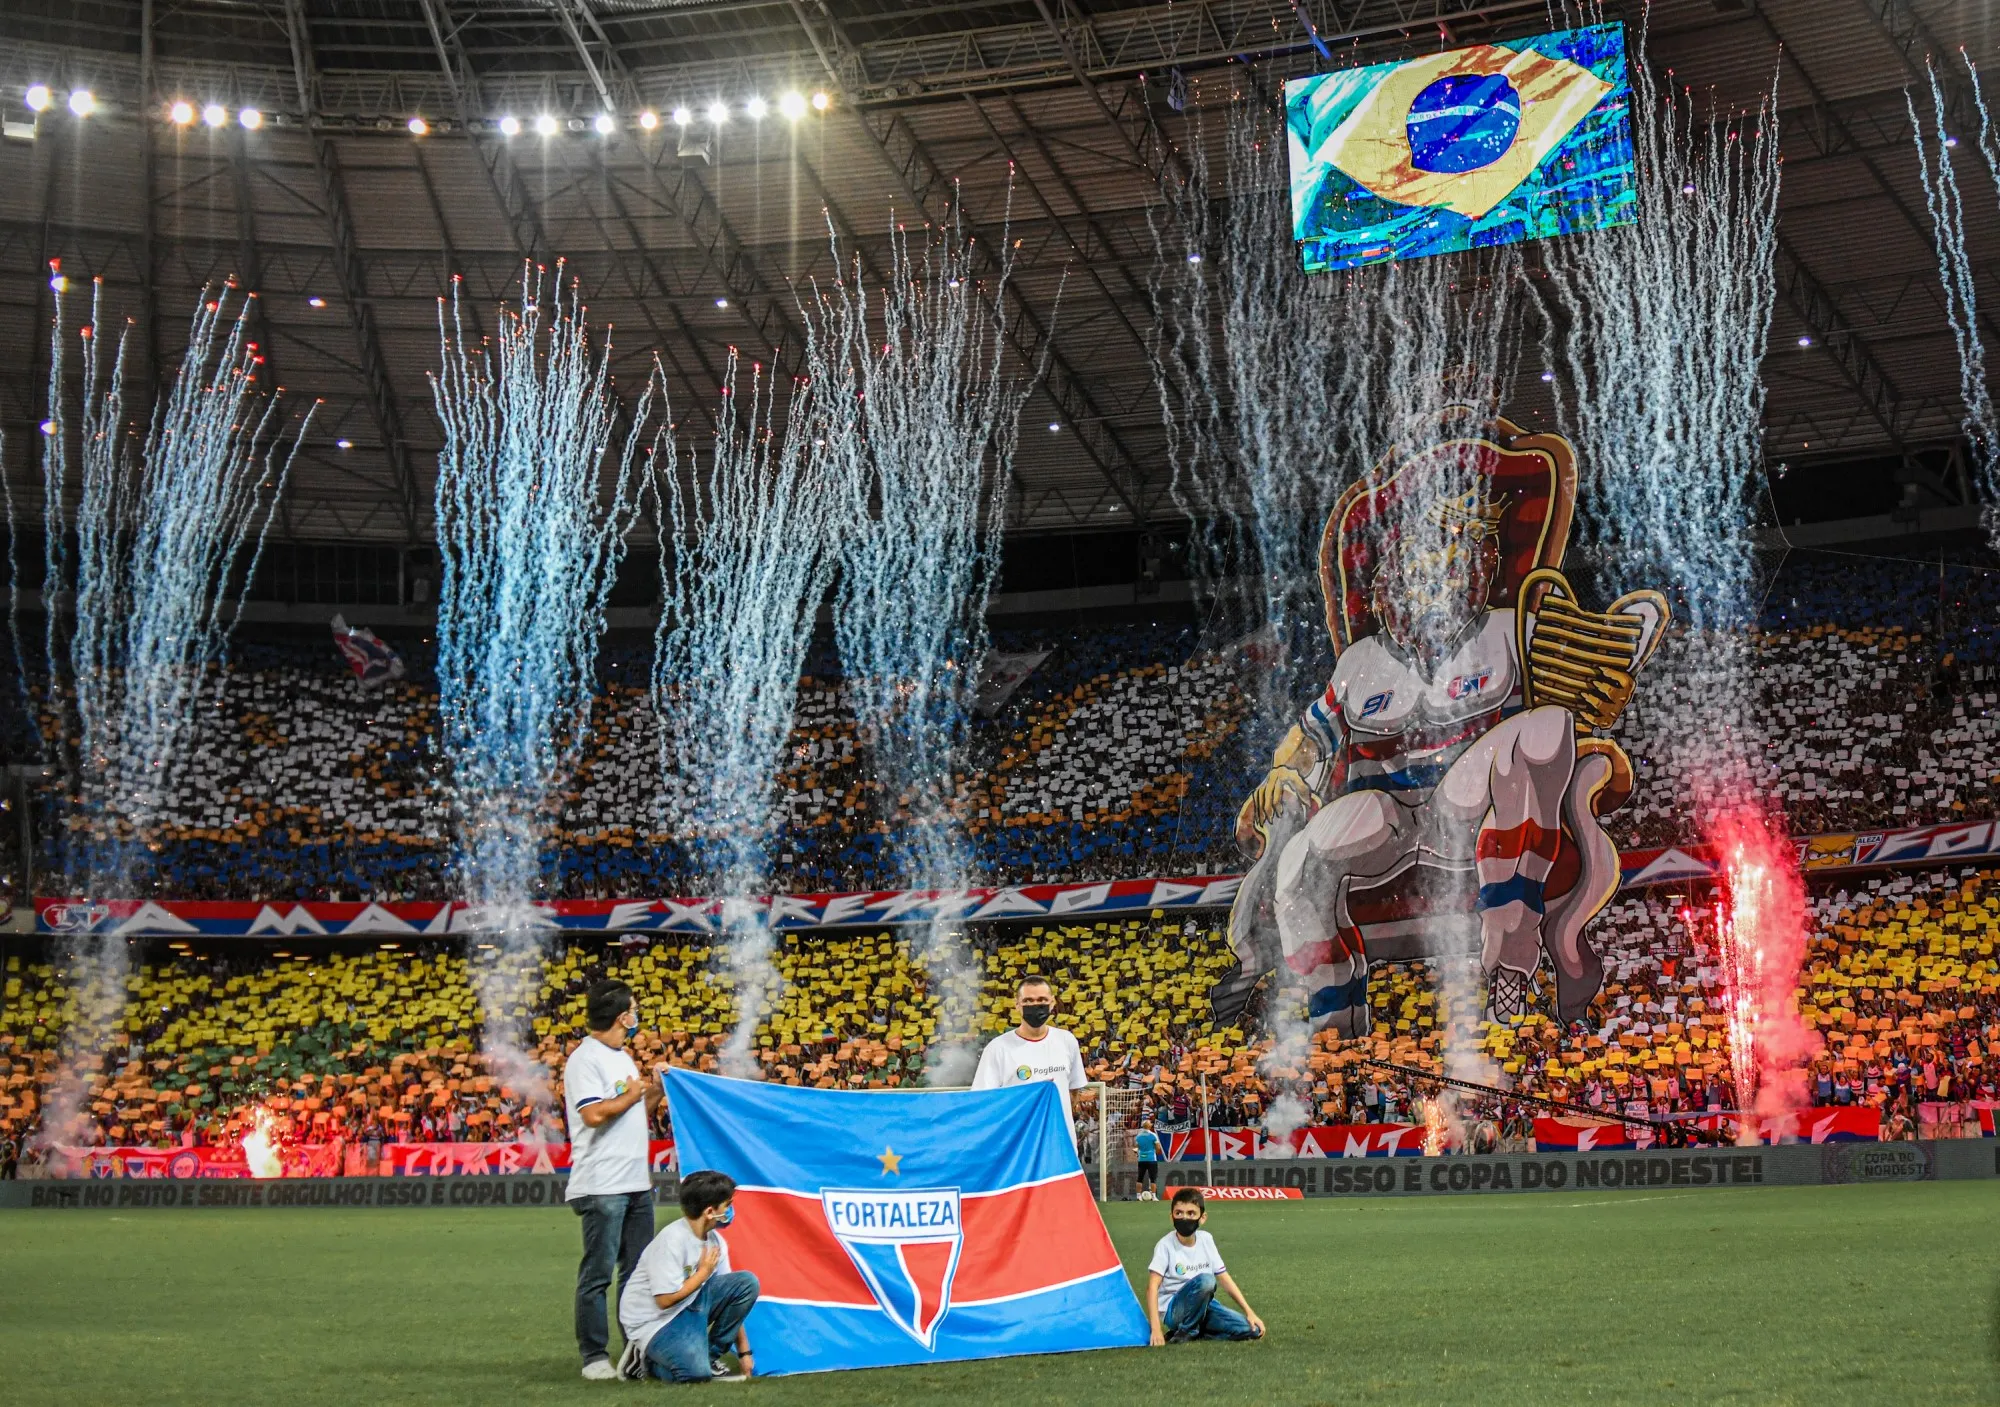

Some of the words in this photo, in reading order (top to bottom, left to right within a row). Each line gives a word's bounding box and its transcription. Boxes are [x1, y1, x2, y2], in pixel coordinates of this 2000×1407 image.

[1873, 821, 2000, 863] FO
[1034, 1065, 1067, 1075] PagBank
[1865, 1153, 1895, 1164] COPA
[1900, 1152, 1915, 1163] DO
[1324, 1164, 1396, 1193] ISSO
[1404, 1159, 1423, 1192] É
[1430, 1161, 1513, 1191] COPA
[1521, 1160, 1568, 1189] DO
[1577, 1155, 1763, 1188] NORDESTE!
[1865, 1163, 1932, 1176] NORDESTE
[84, 1184, 114, 1207] NO
[118, 1184, 178, 1207] PEITO
[181, 1184, 196, 1207] E
[199, 1183, 266, 1207] SENTE
[267, 1182, 373, 1207] ORGULHO!
[377, 1181, 427, 1207] ISSO
[431, 1176, 446, 1206] É
[450, 1180, 508, 1205] COPA
[512, 1179, 546, 1204] DO
[1217, 1187, 1289, 1200] KRONA
[832, 1200, 955, 1228] FORTALEZA
